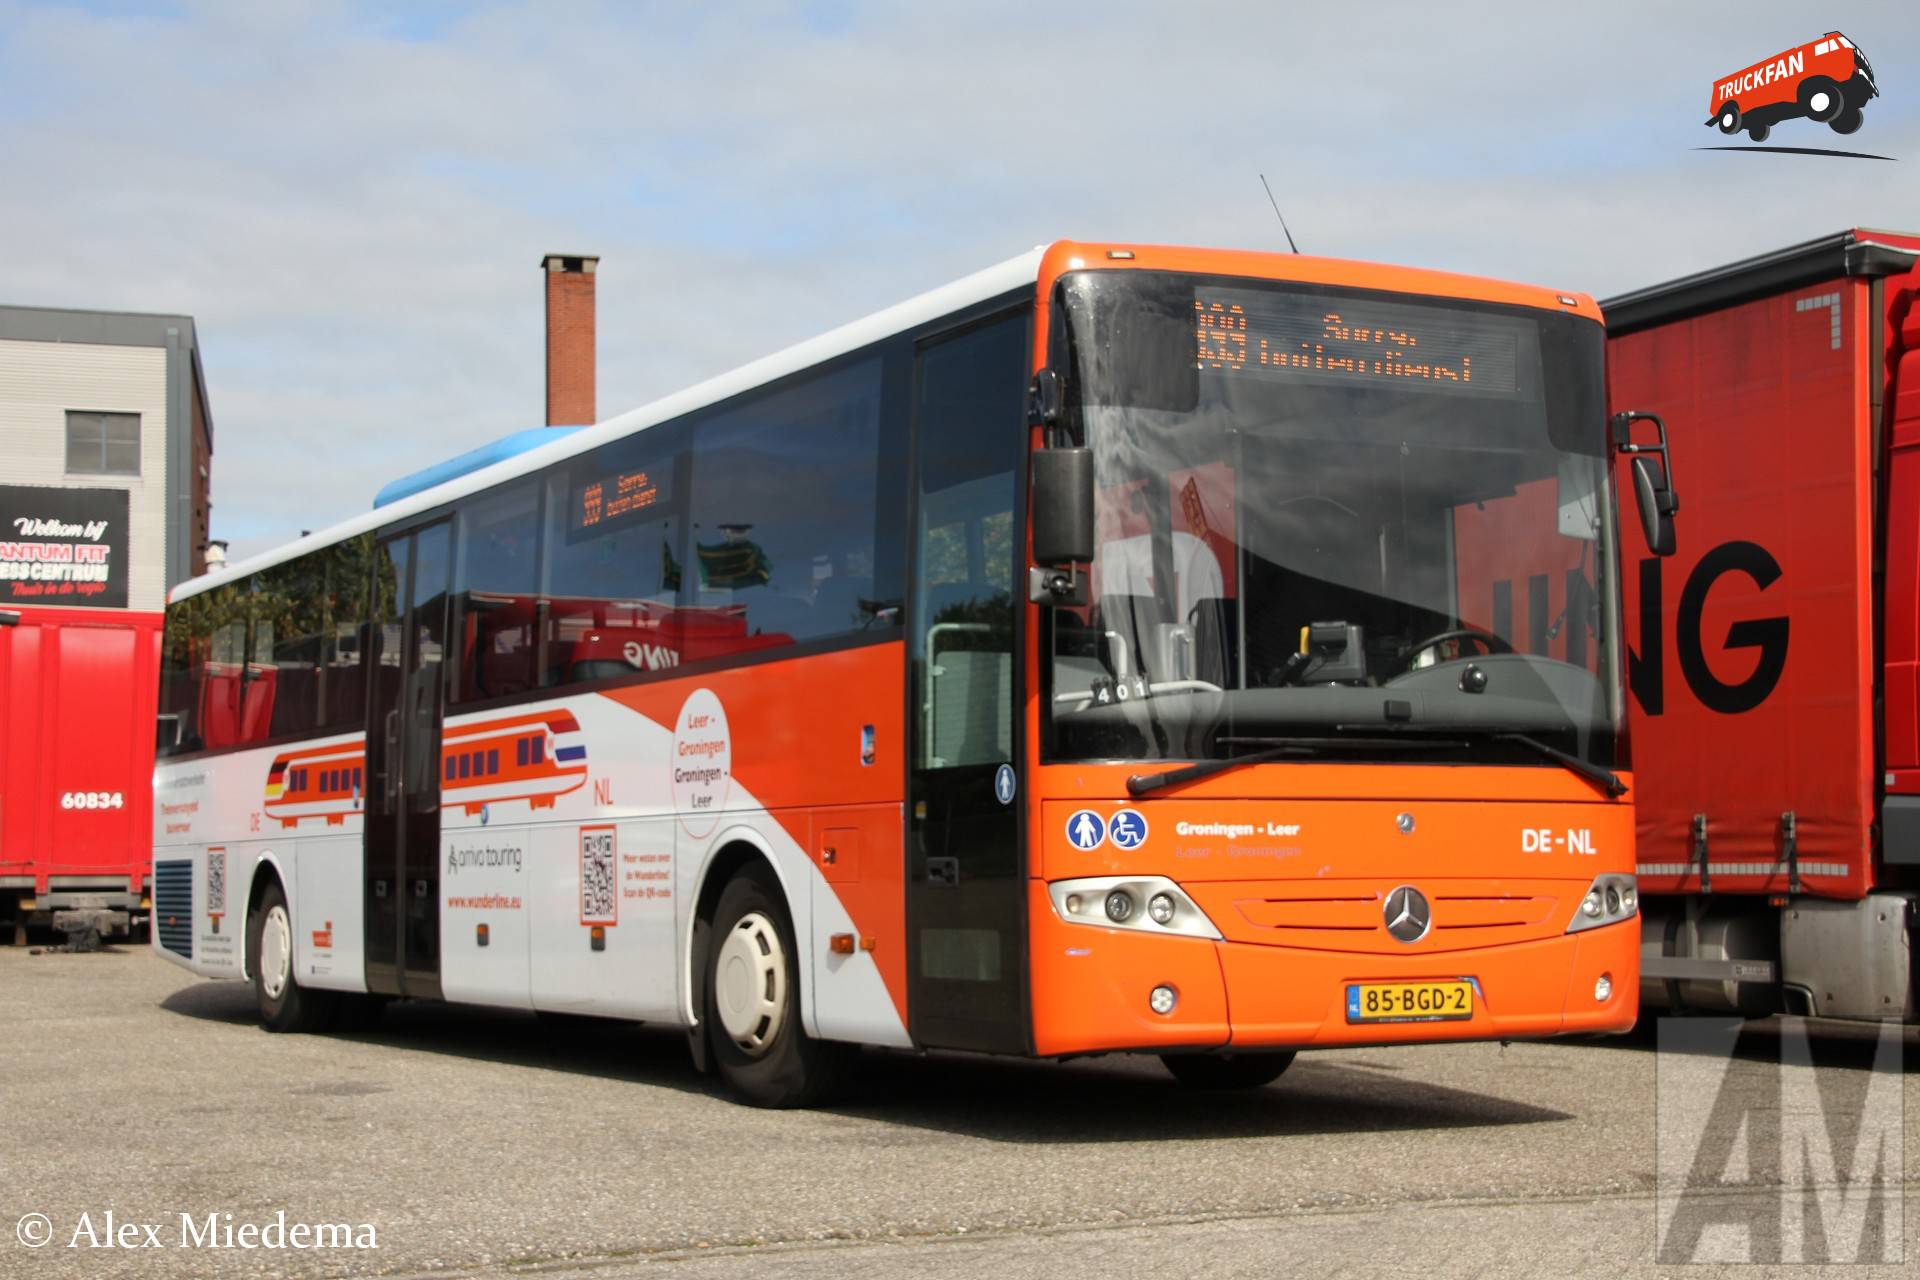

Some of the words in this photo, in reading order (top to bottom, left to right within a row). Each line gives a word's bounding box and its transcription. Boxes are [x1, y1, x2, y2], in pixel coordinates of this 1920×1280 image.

[13, 518, 83, 537] Welkom
[678, 740, 726, 759] Groningen
[674, 767, 722, 786] Groningen
[61, 792, 124, 810] 60834
[594, 779, 613, 806] NL
[691, 793, 712, 809] Leer
[1175, 821, 1254, 840] Groningen
[1266, 821, 1300, 836] Leer
[486, 843, 521, 873] touring
[1367, 988, 1466, 1012] 85-BGD-2
